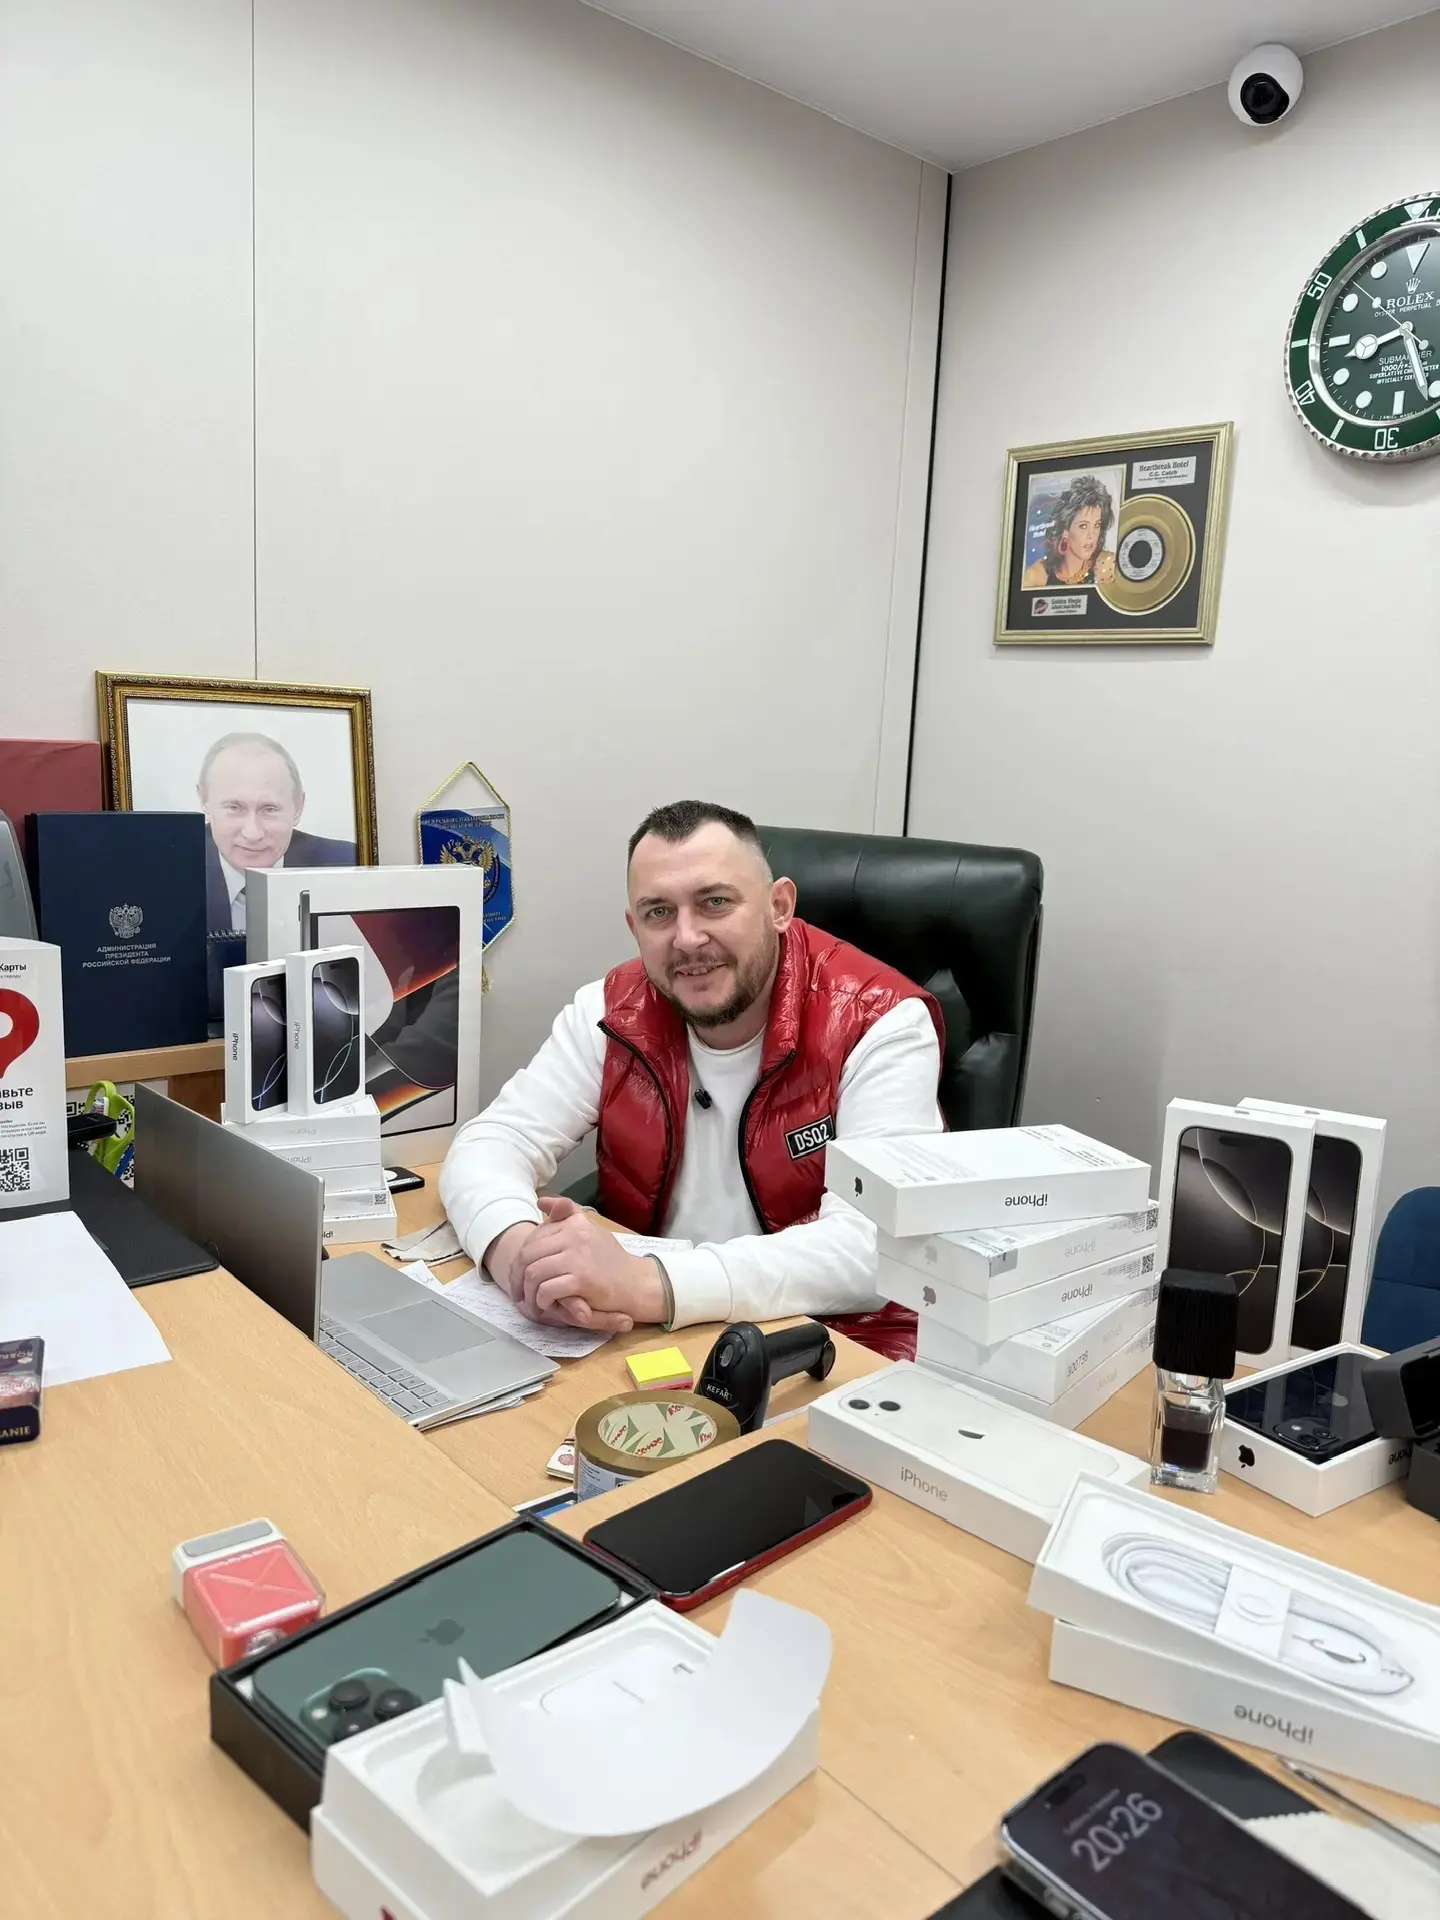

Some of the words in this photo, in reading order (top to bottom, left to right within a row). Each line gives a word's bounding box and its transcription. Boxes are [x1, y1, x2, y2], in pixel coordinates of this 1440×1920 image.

[1306, 271, 1333, 300] 50
[1386, 291, 1434, 310] ROLEX
[1294, 379, 1316, 406] 40
[1374, 427, 1400, 450] 30
[1139, 462, 1172, 472] Heartbreak
[1172, 460, 1190, 469] Hotel
[96, 943, 157, 953] АДМИНИСТРАЦИЯ
[105, 950, 149, 960] ПРЕЗИДЕНТА
[82, 958, 129, 968] РОССИЙСКОЙ
[130, 956, 171, 965] ФЕДЕРАЦИИ
[232, 1032, 240, 1061] iPhone
[0, 1087, 34, 1099] вьте
[793, 1123, 830, 1152] DSQ2
[1004, 1193, 1048, 1207] iPhone
[1064, 1239, 1096, 1258] iPhone
[1061, 1283, 1094, 1302] iPhone
[0, 1425, 31, 1437] ANIE
[900, 1466, 948, 1502] iPhone
[1234, 1704, 1314, 1745] iPhone
[1071, 1792, 1163, 1873] 20:26
[640, 1828, 703, 1893] iPhone
